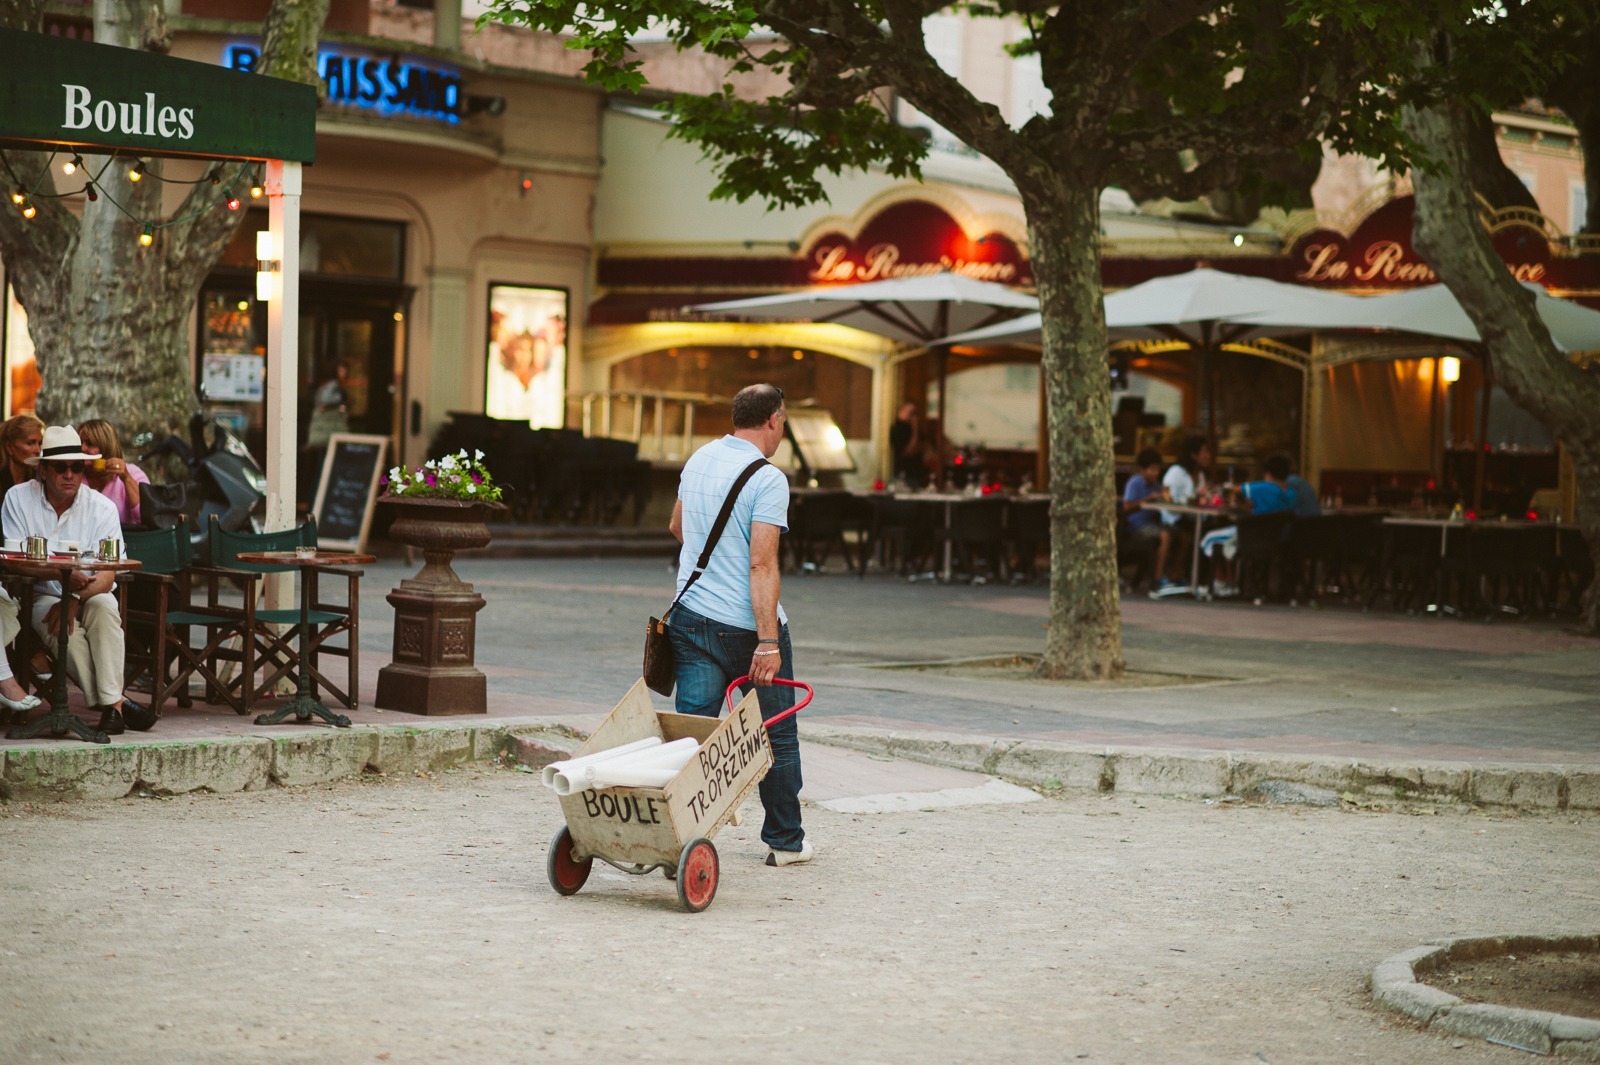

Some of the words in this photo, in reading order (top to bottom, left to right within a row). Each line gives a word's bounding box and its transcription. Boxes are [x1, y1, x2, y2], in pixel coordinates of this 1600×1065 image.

[61, 84, 194, 140] Boules
[808, 245, 855, 281] La
[1297, 243, 1350, 281] La
[698, 707, 751, 780] BOULE
[687, 723, 767, 824] TROPEZIENNE
[582, 788, 661, 824] BOULE
